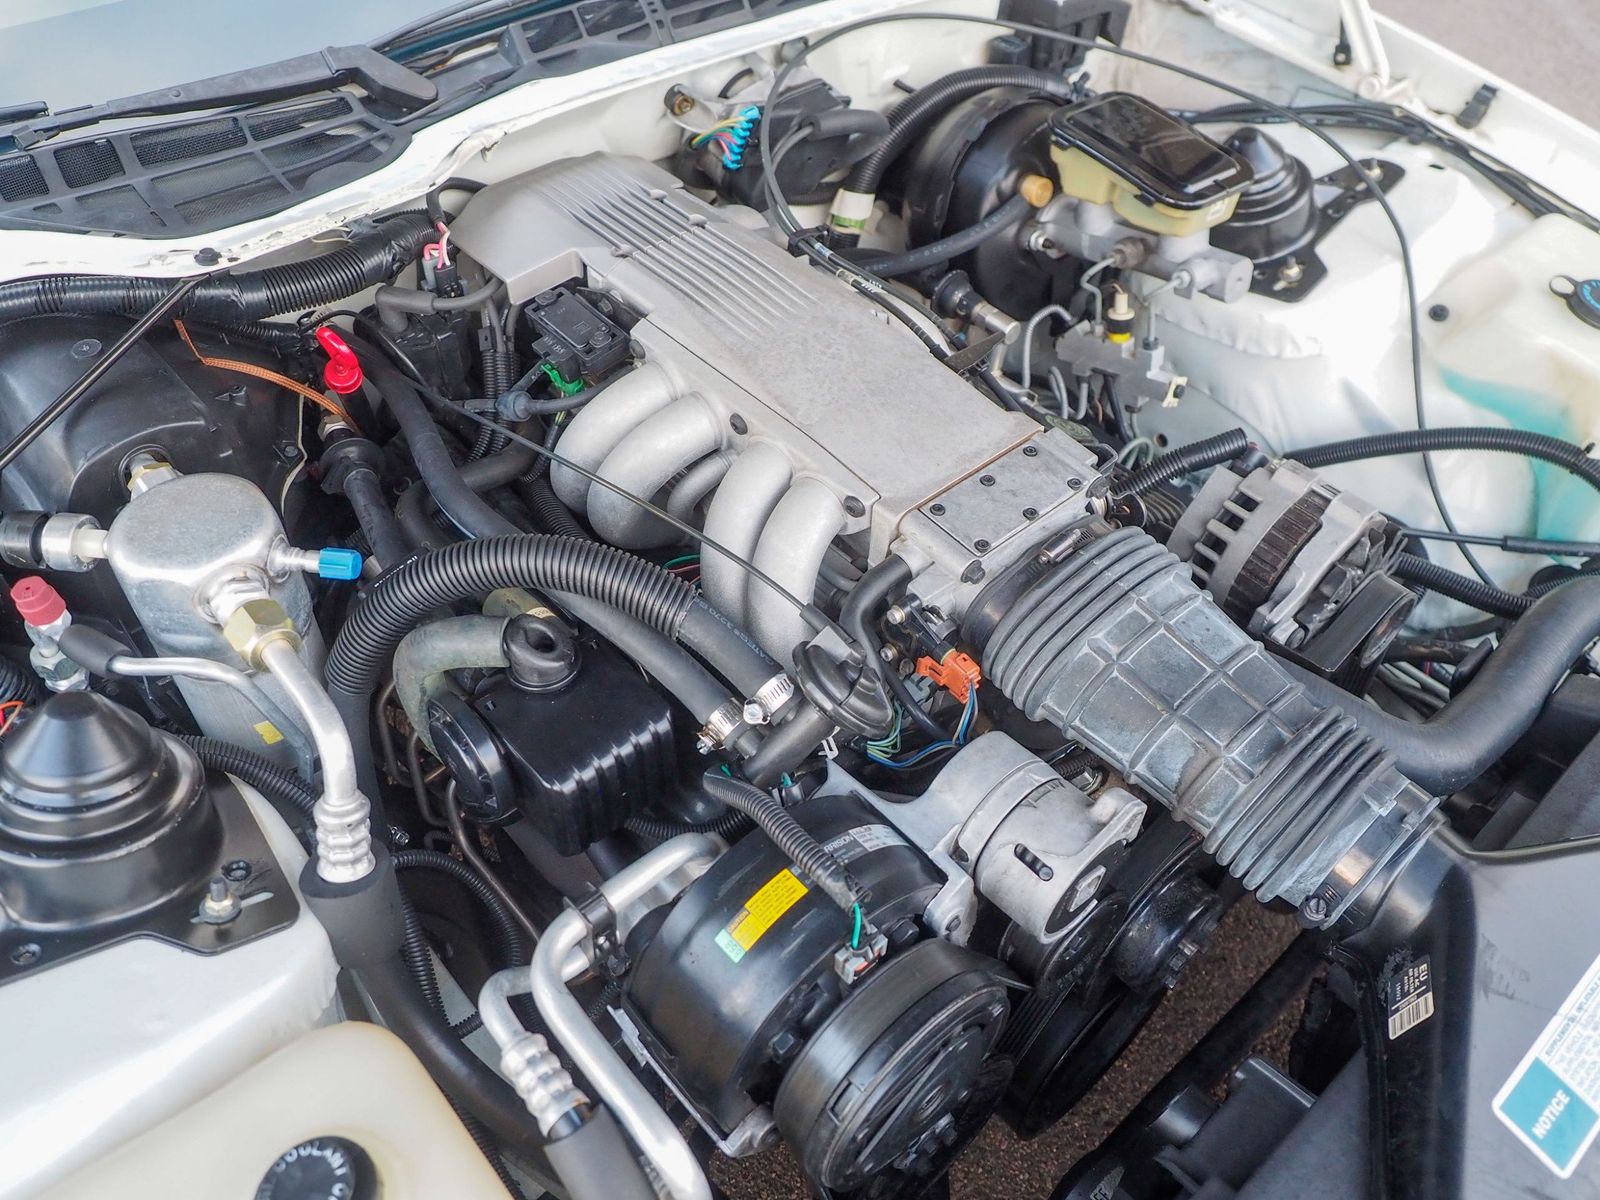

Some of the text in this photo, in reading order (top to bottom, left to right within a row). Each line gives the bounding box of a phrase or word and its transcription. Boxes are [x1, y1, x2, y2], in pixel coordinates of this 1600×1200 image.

[823, 834, 854, 853] RRISON
[1419, 963, 1428, 981] EU
[1531, 1088, 1571, 1140] NOTICE
